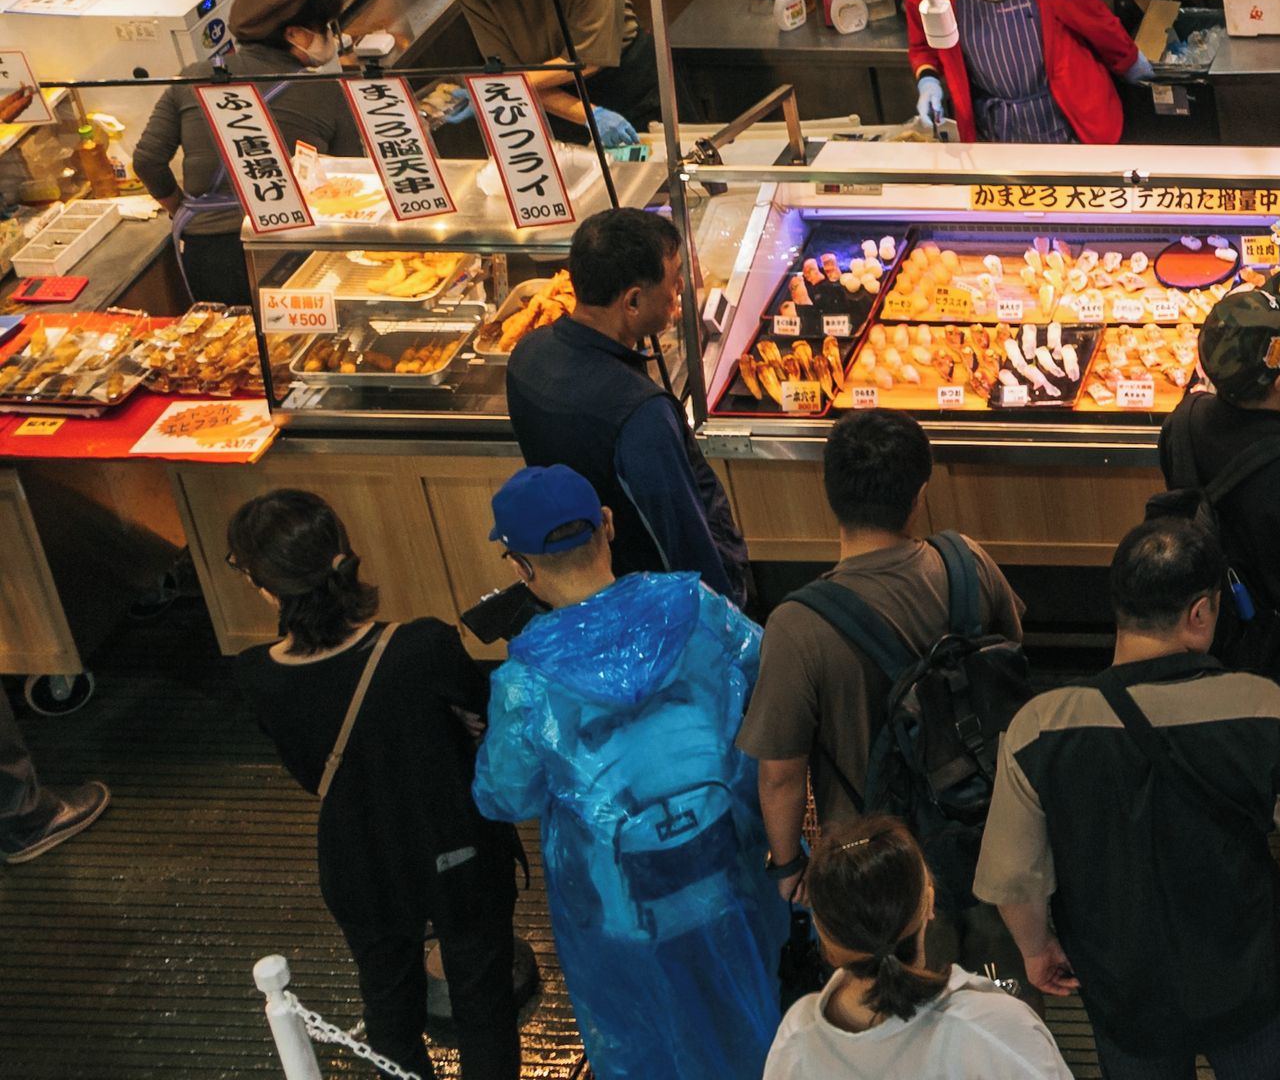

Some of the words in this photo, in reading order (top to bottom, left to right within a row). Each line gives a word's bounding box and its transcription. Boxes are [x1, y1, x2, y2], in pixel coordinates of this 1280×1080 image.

[216, 91, 287, 203] ふく唐揚げ
[358, 83, 435, 195] まぐろ脳天串
[484, 82, 548, 198] えびフライ
[400, 197, 448, 214] 200円
[975, 185, 1058, 207] かまとろ
[1065, 185, 1128, 209] 大とろ
[259, 210, 306, 228] 500円
[520, 203, 566, 220] 300円
[267, 295, 325, 310] ふく唐揚げ
[289, 313, 327, 326] ¥500
[785, 391, 817, 403] 一本穴子
